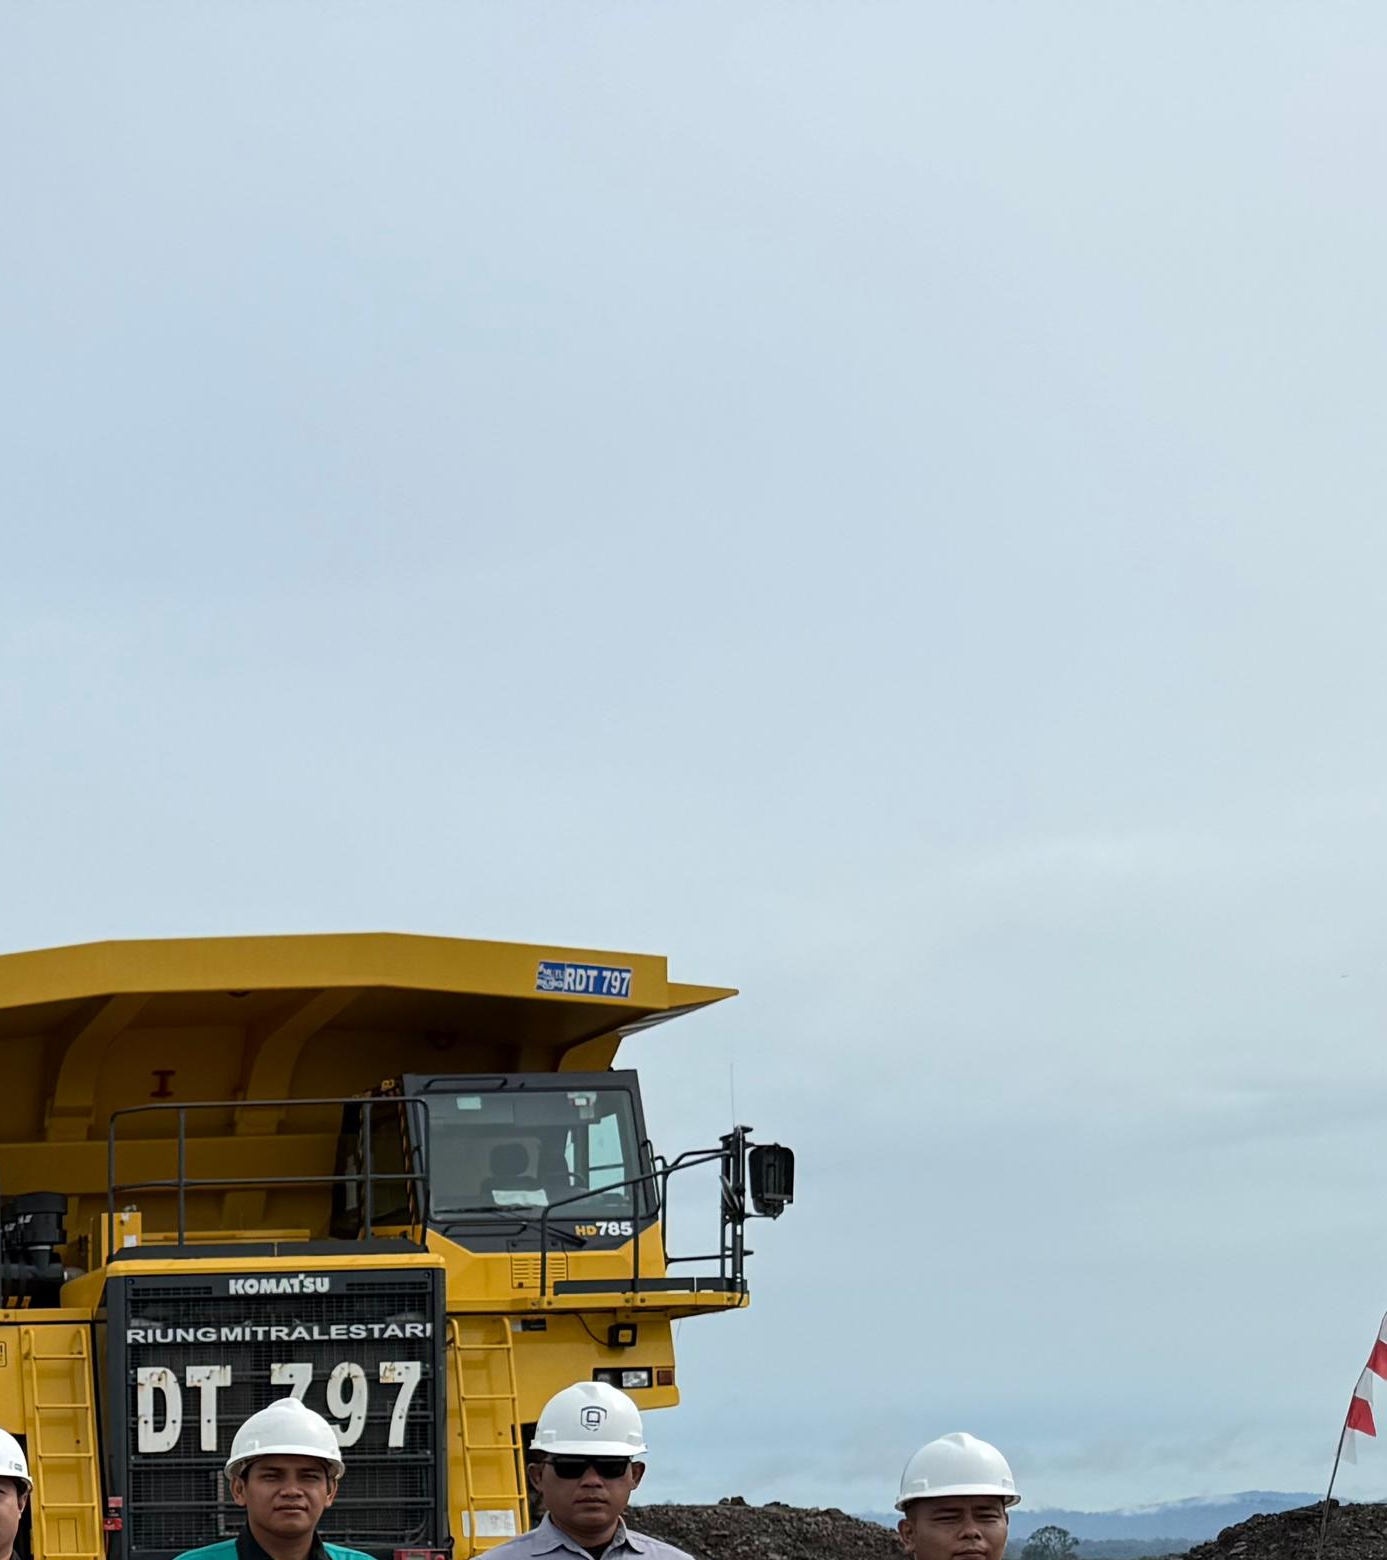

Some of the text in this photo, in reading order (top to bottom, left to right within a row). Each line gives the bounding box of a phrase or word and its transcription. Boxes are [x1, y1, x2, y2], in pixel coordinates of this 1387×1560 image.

[565, 967, 598, 992] RDT
[602, 970, 632, 995] 797
[575, 1221, 633, 1236] HD785
[229, 1274, 329, 1295] KOMATSU
[137, 1364, 232, 1454] DT
